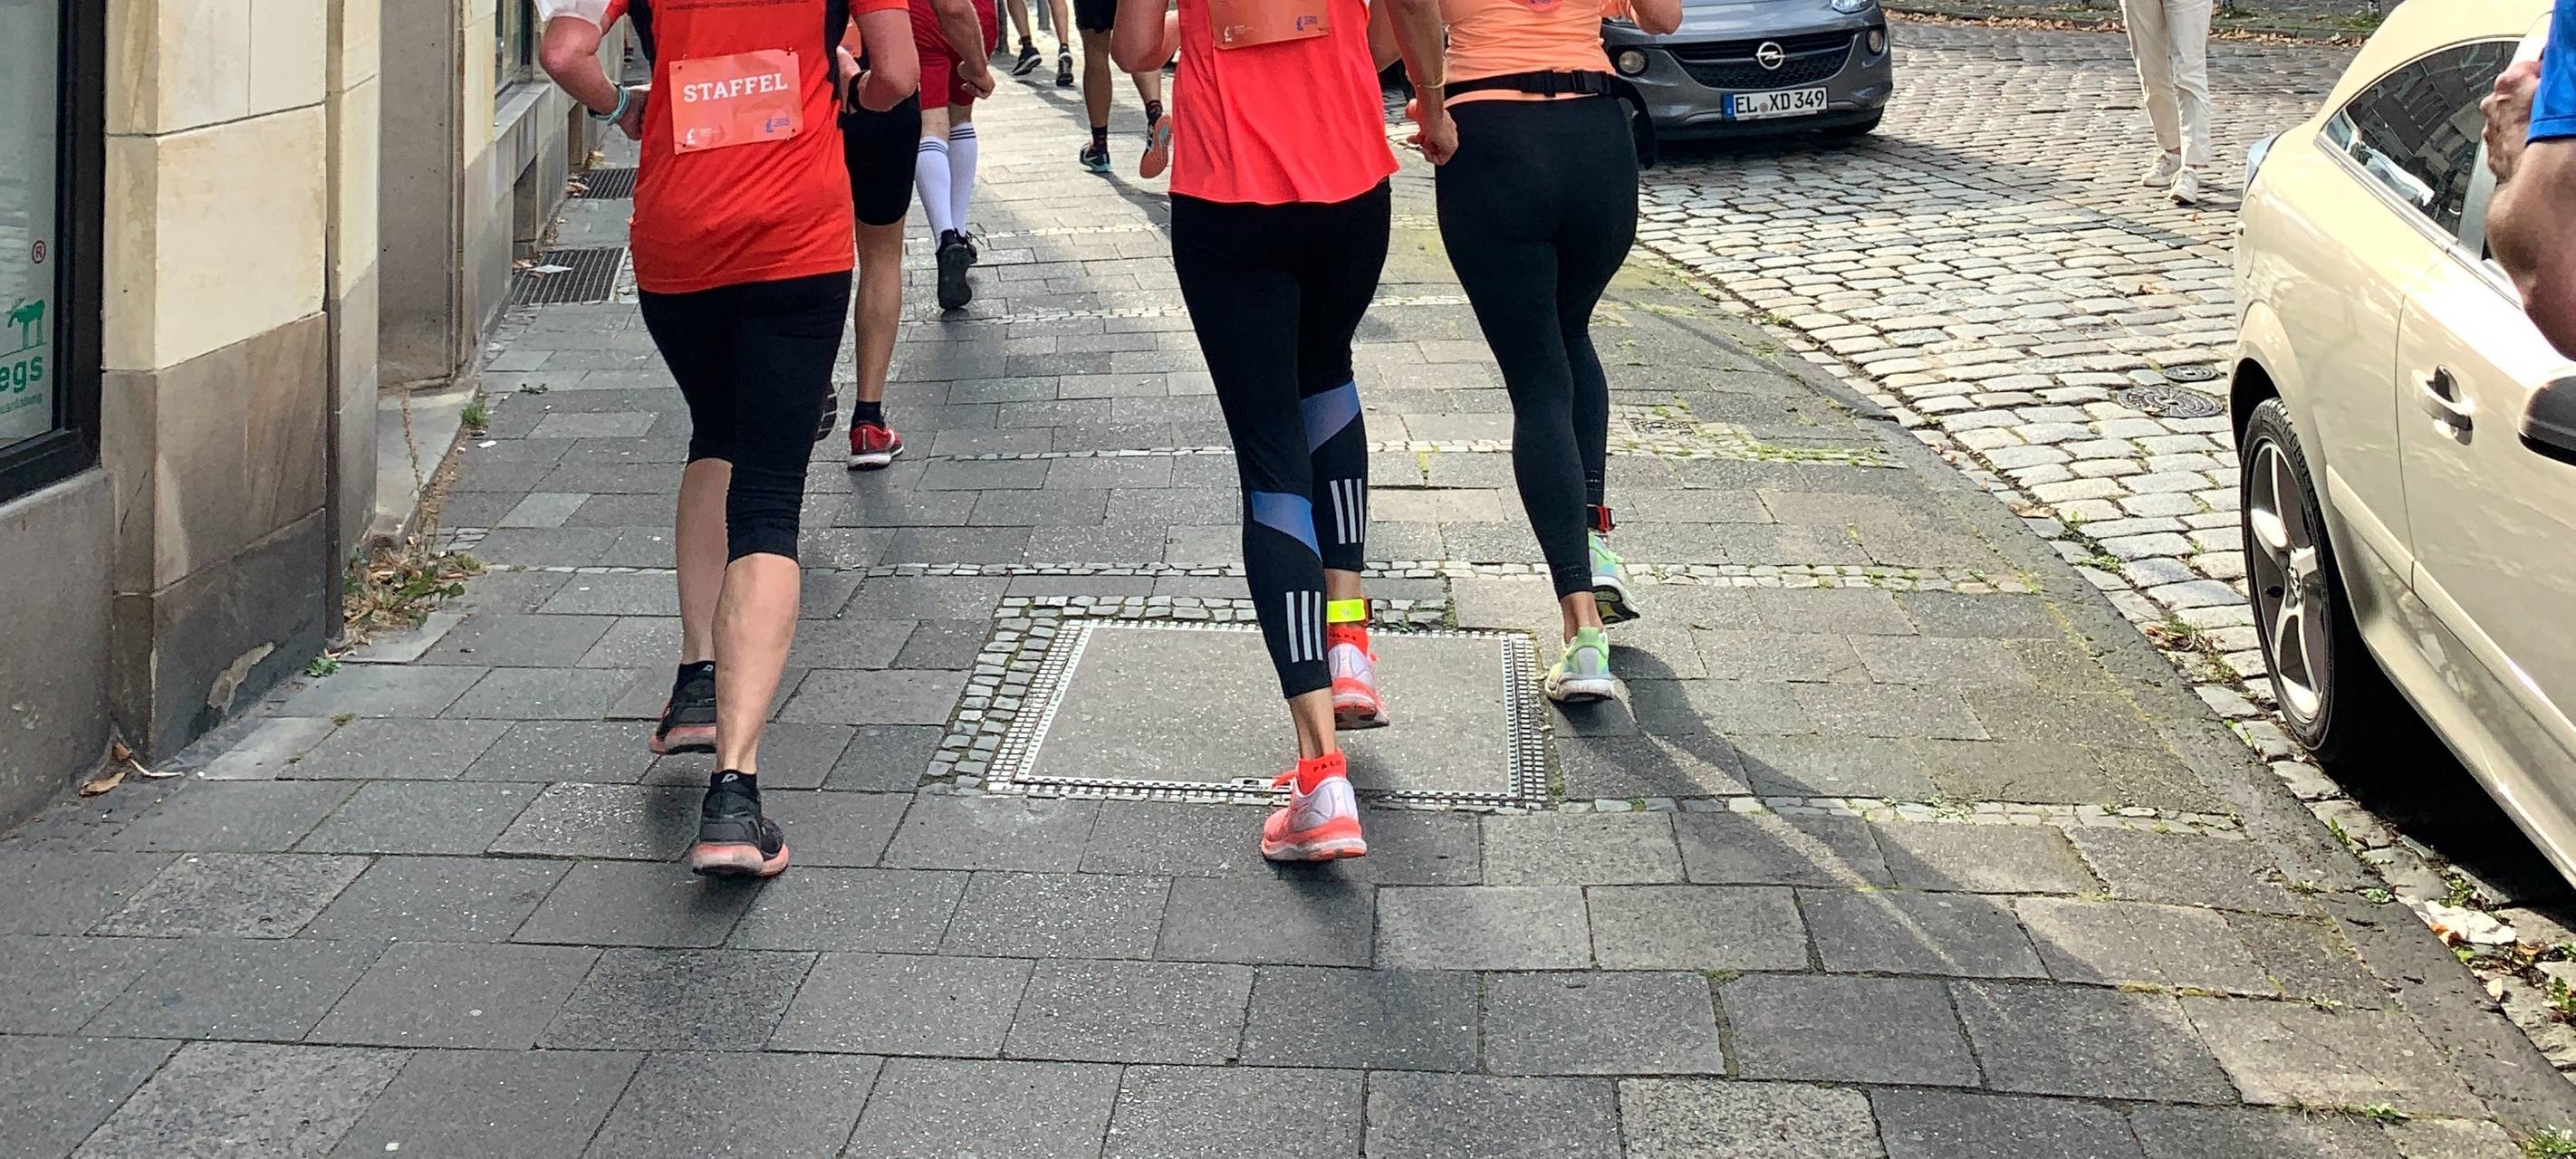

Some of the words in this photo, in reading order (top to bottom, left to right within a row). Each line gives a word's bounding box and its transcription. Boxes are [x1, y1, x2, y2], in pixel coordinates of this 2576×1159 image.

[683, 72, 787, 102] STAFFEL
[1735, 95, 1757, 114] EL
[1769, 92, 1791, 111] XD
[1794, 90, 1824, 108] 349
